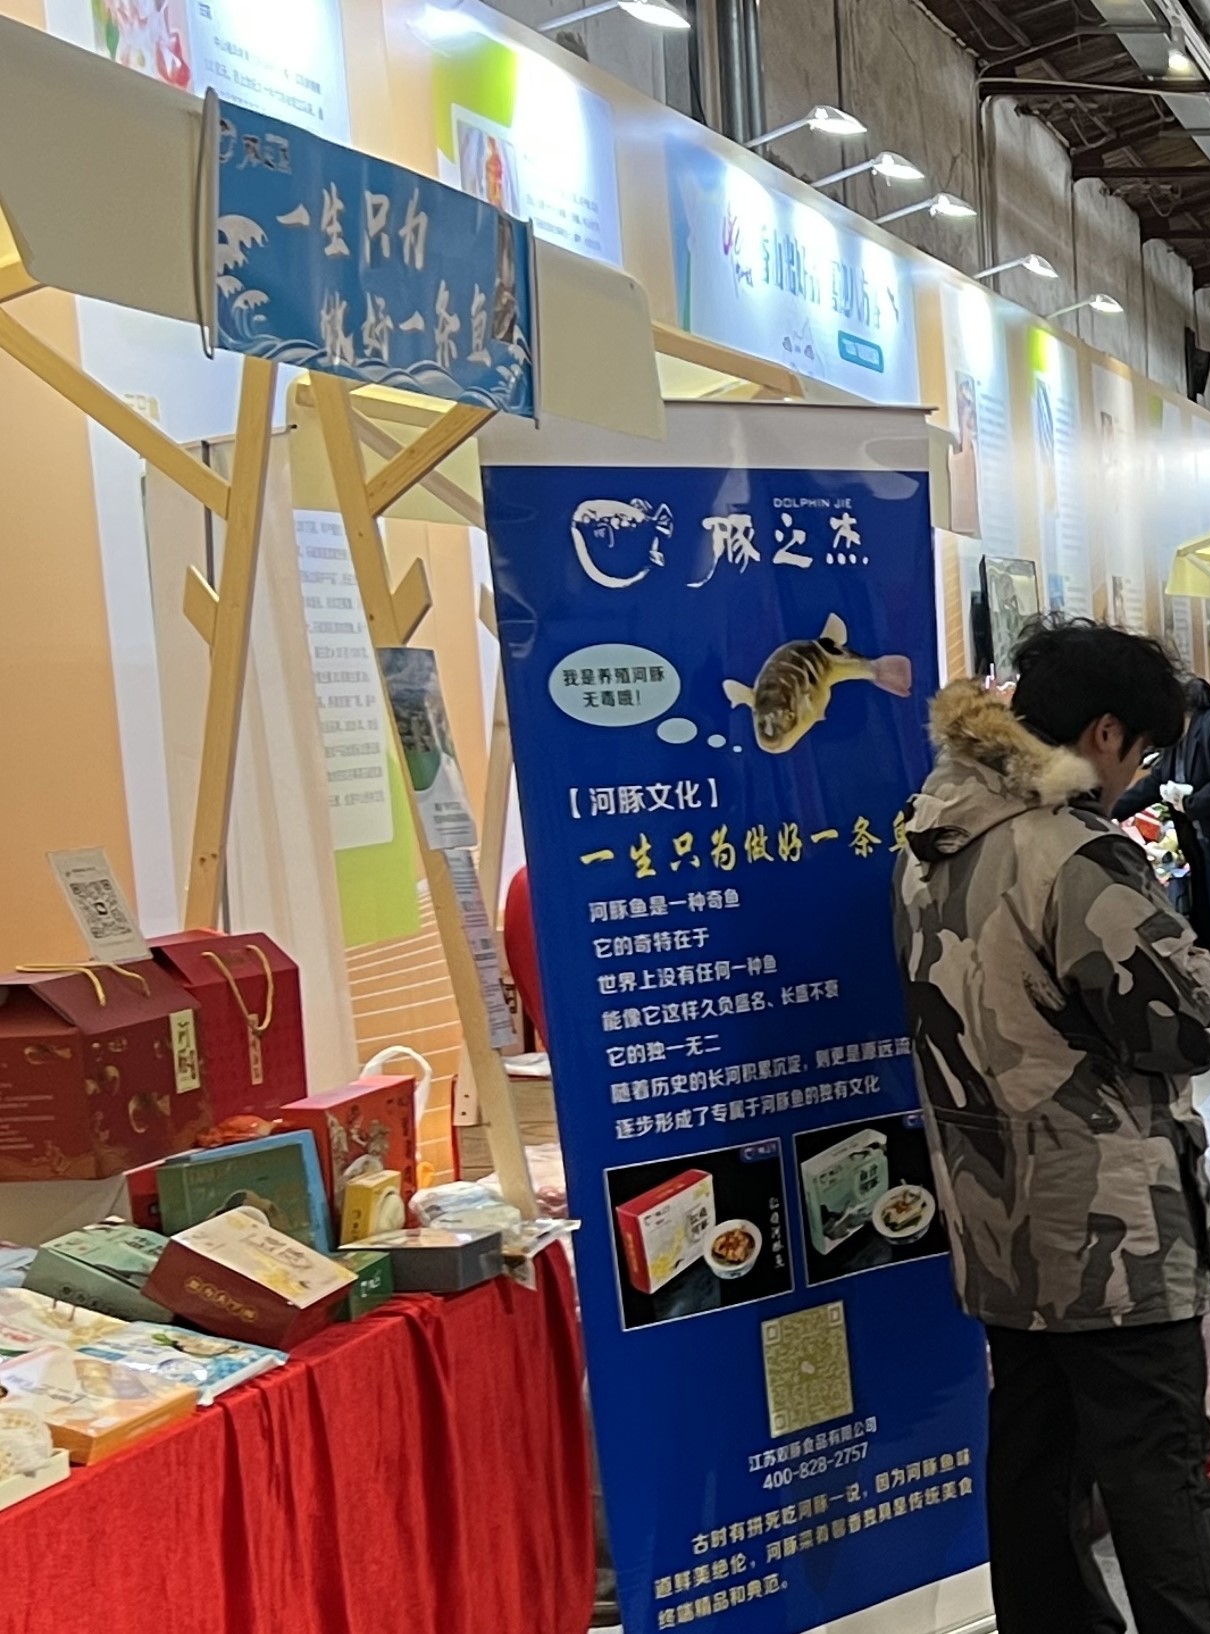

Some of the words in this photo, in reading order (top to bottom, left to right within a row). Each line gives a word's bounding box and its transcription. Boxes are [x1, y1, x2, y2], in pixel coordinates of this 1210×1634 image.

[773, 498, 830, 508] DOLPHIN
[834, 498, 852, 508] JIE
[562, 665, 664, 686] 我是养殖河豚
[589, 888, 741, 923] 河豚鱼是一种奇鱼
[593, 928, 710, 958] 它的奇特在于
[597, 954, 778, 995] 世界上没有任何一种鱼
[602, 979, 839, 1032] 能像它这样久负盛名、长盛不衰
[606, 1034, 722, 1067] 它的独一无二
[763, 1441, 869, 1489] 400-828-2757
